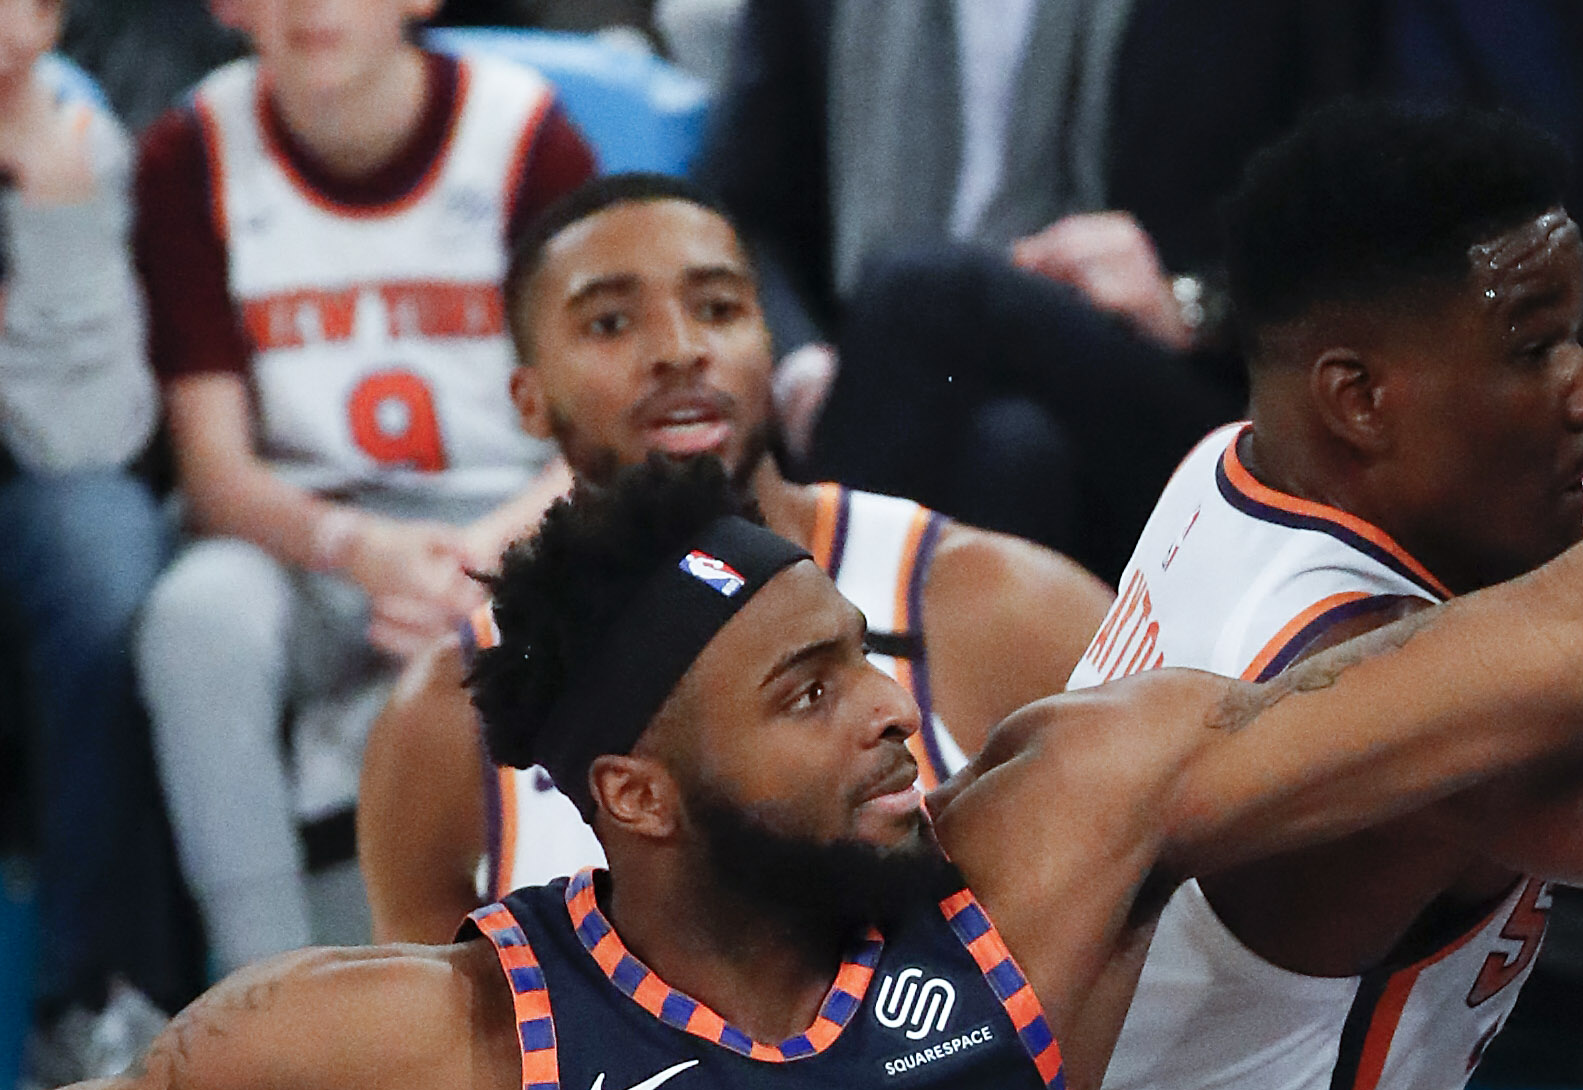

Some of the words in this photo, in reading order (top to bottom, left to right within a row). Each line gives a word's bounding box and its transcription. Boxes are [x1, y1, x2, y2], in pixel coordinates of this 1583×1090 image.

[347, 369, 446, 474] 9
[1086, 568, 1164, 683] AYTO
[884, 1025, 994, 1076] SQUARESPACE
